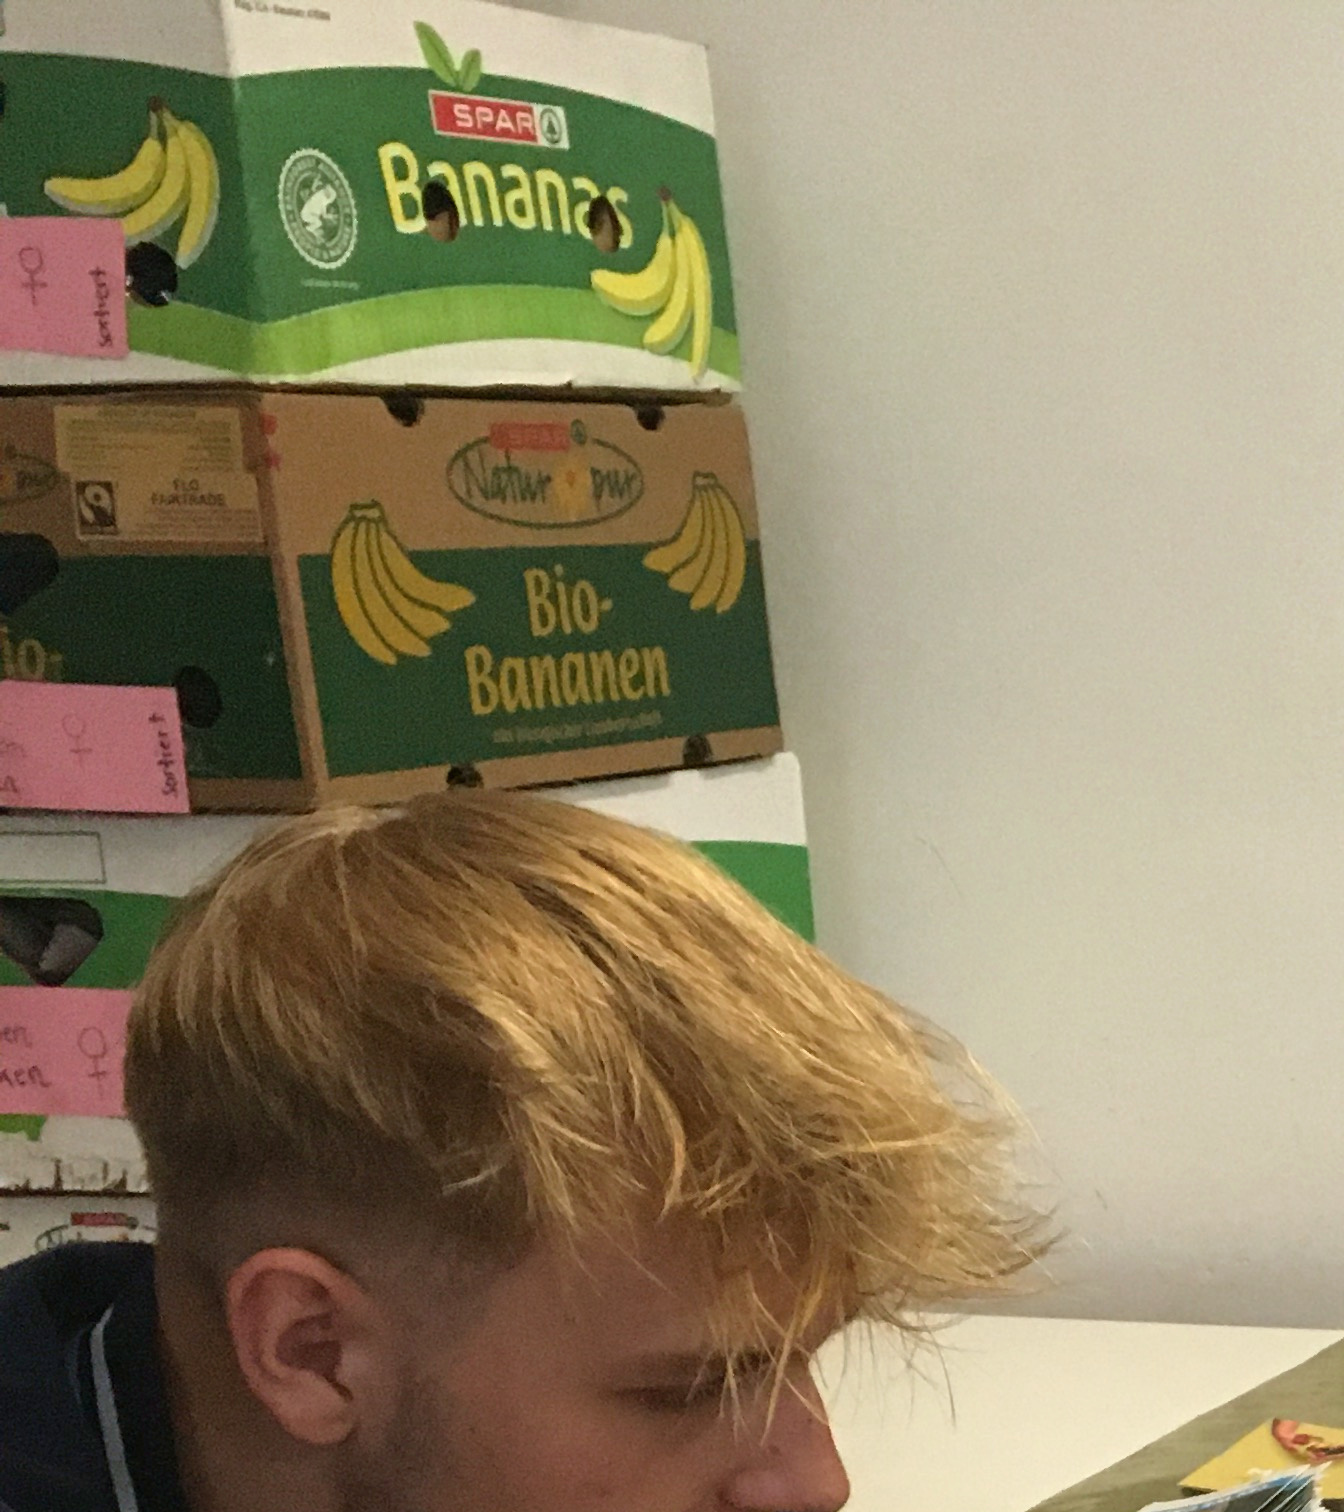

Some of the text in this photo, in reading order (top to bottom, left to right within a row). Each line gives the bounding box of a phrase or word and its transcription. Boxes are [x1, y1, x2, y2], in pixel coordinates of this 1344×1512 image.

[452, 103, 535, 135] SPAR
[378, 141, 633, 249] Bananas
[462, 446, 638, 512] Natur pur
[523, 563, 613, 637] Bio-
[464, 643, 671, 716] Bananen
